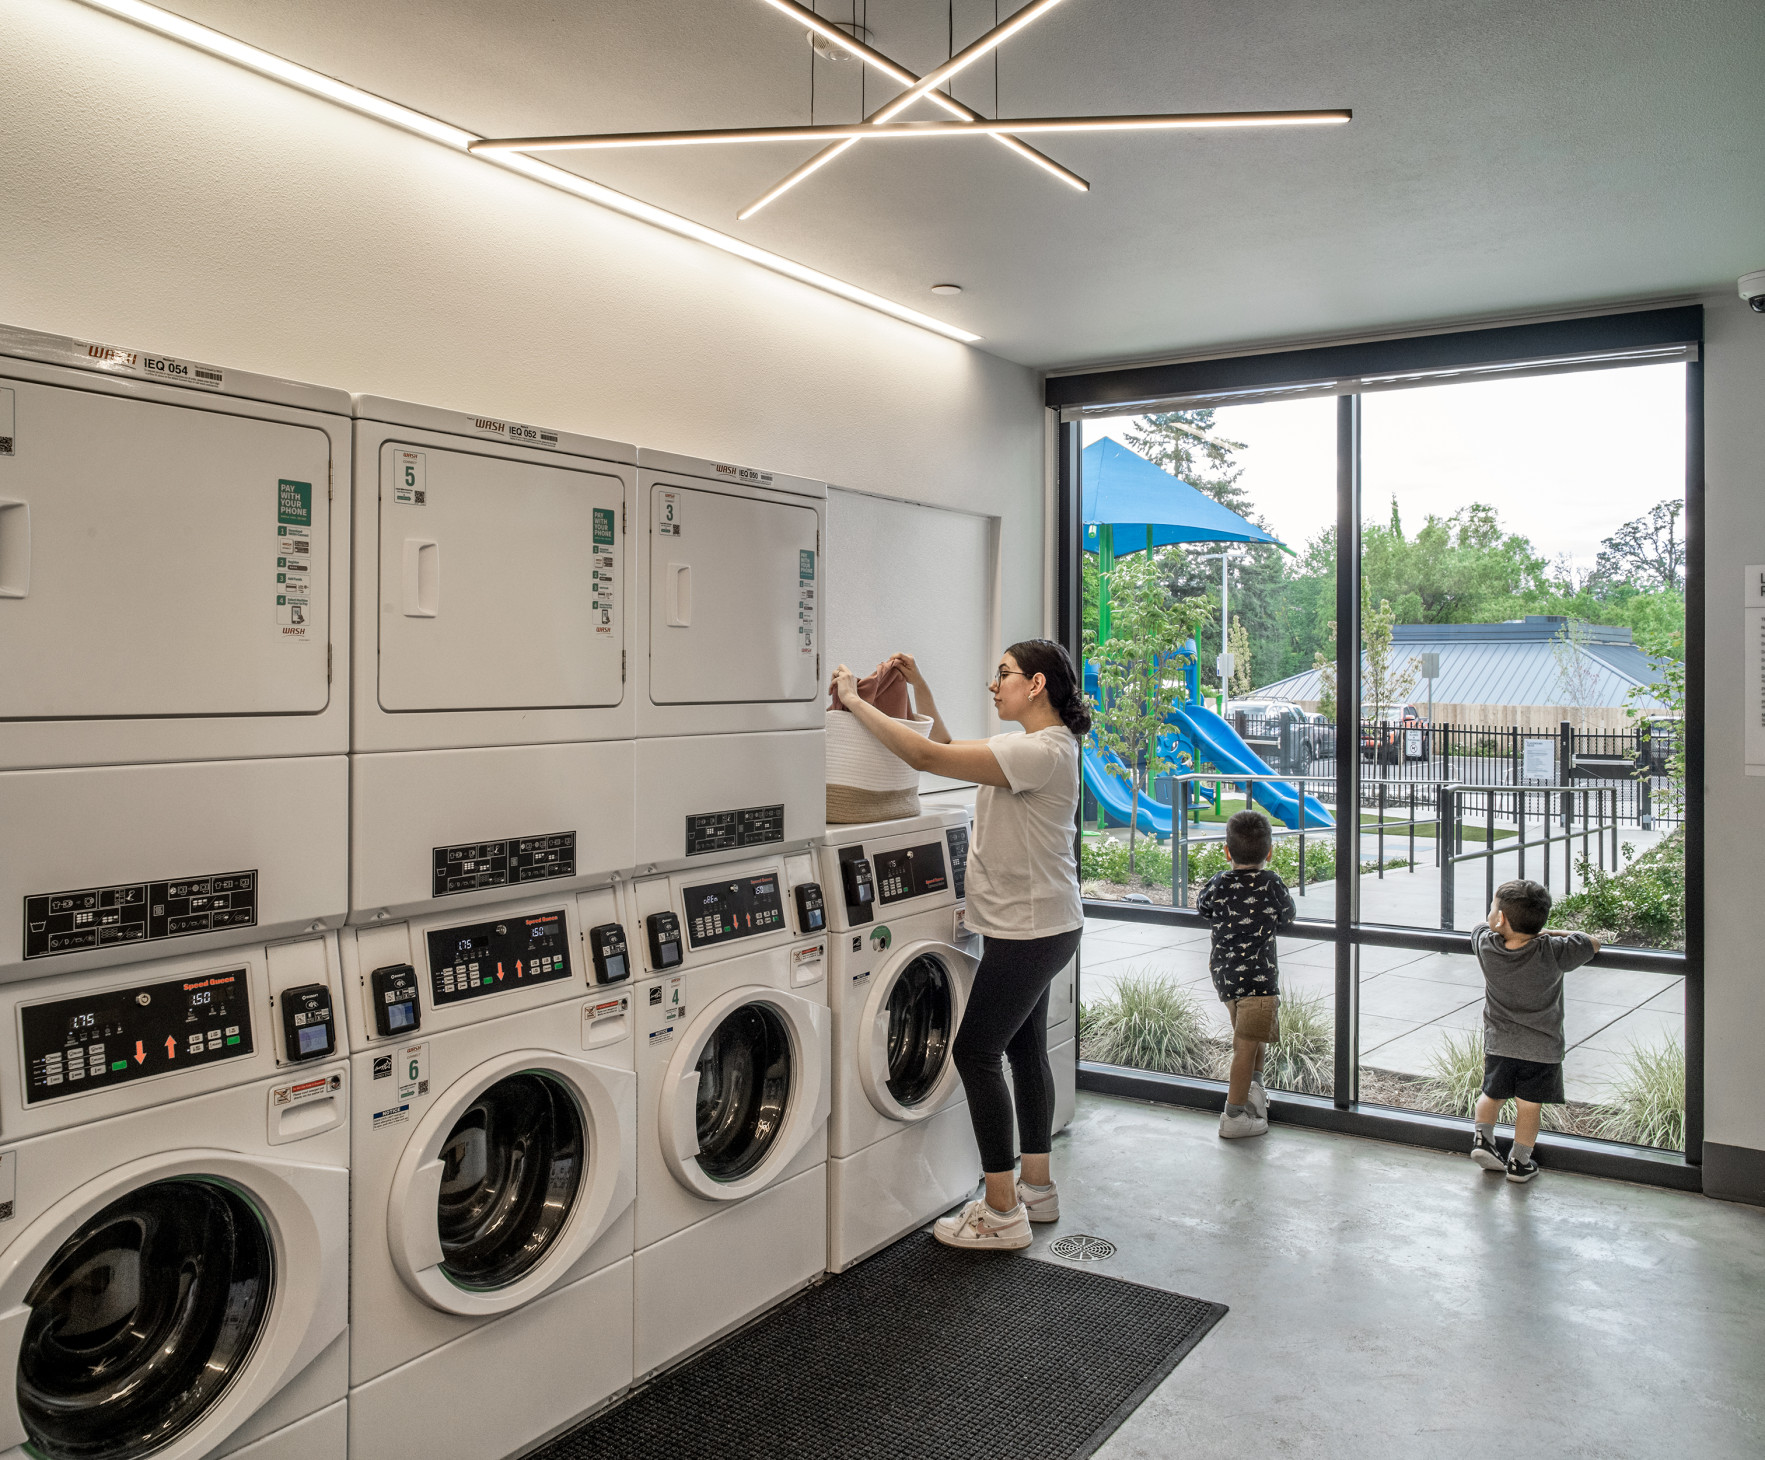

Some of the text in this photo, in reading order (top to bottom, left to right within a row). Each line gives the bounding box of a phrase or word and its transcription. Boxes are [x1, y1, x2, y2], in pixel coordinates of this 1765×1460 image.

[88, 346, 137, 365] WAH
[144, 358, 165, 372] IEQ
[168, 362, 188, 376] 054
[476, 418, 505, 432] WASH
[509, 426, 522, 436] IEQ
[524, 429, 536, 439] 052
[716, 464, 736, 474] WASH
[405, 466, 415, 486] 5
[281, 484, 295, 492] PAY
[281, 492, 300, 500] WITH
[281, 500, 302, 508] YOUR
[281, 507, 307, 516] PHONE
[666, 504, 673, 521] 3
[184, 977, 234, 990] Speed Queen
[672, 989, 679, 1005] 4
[409, 1060, 419, 1080] 6
